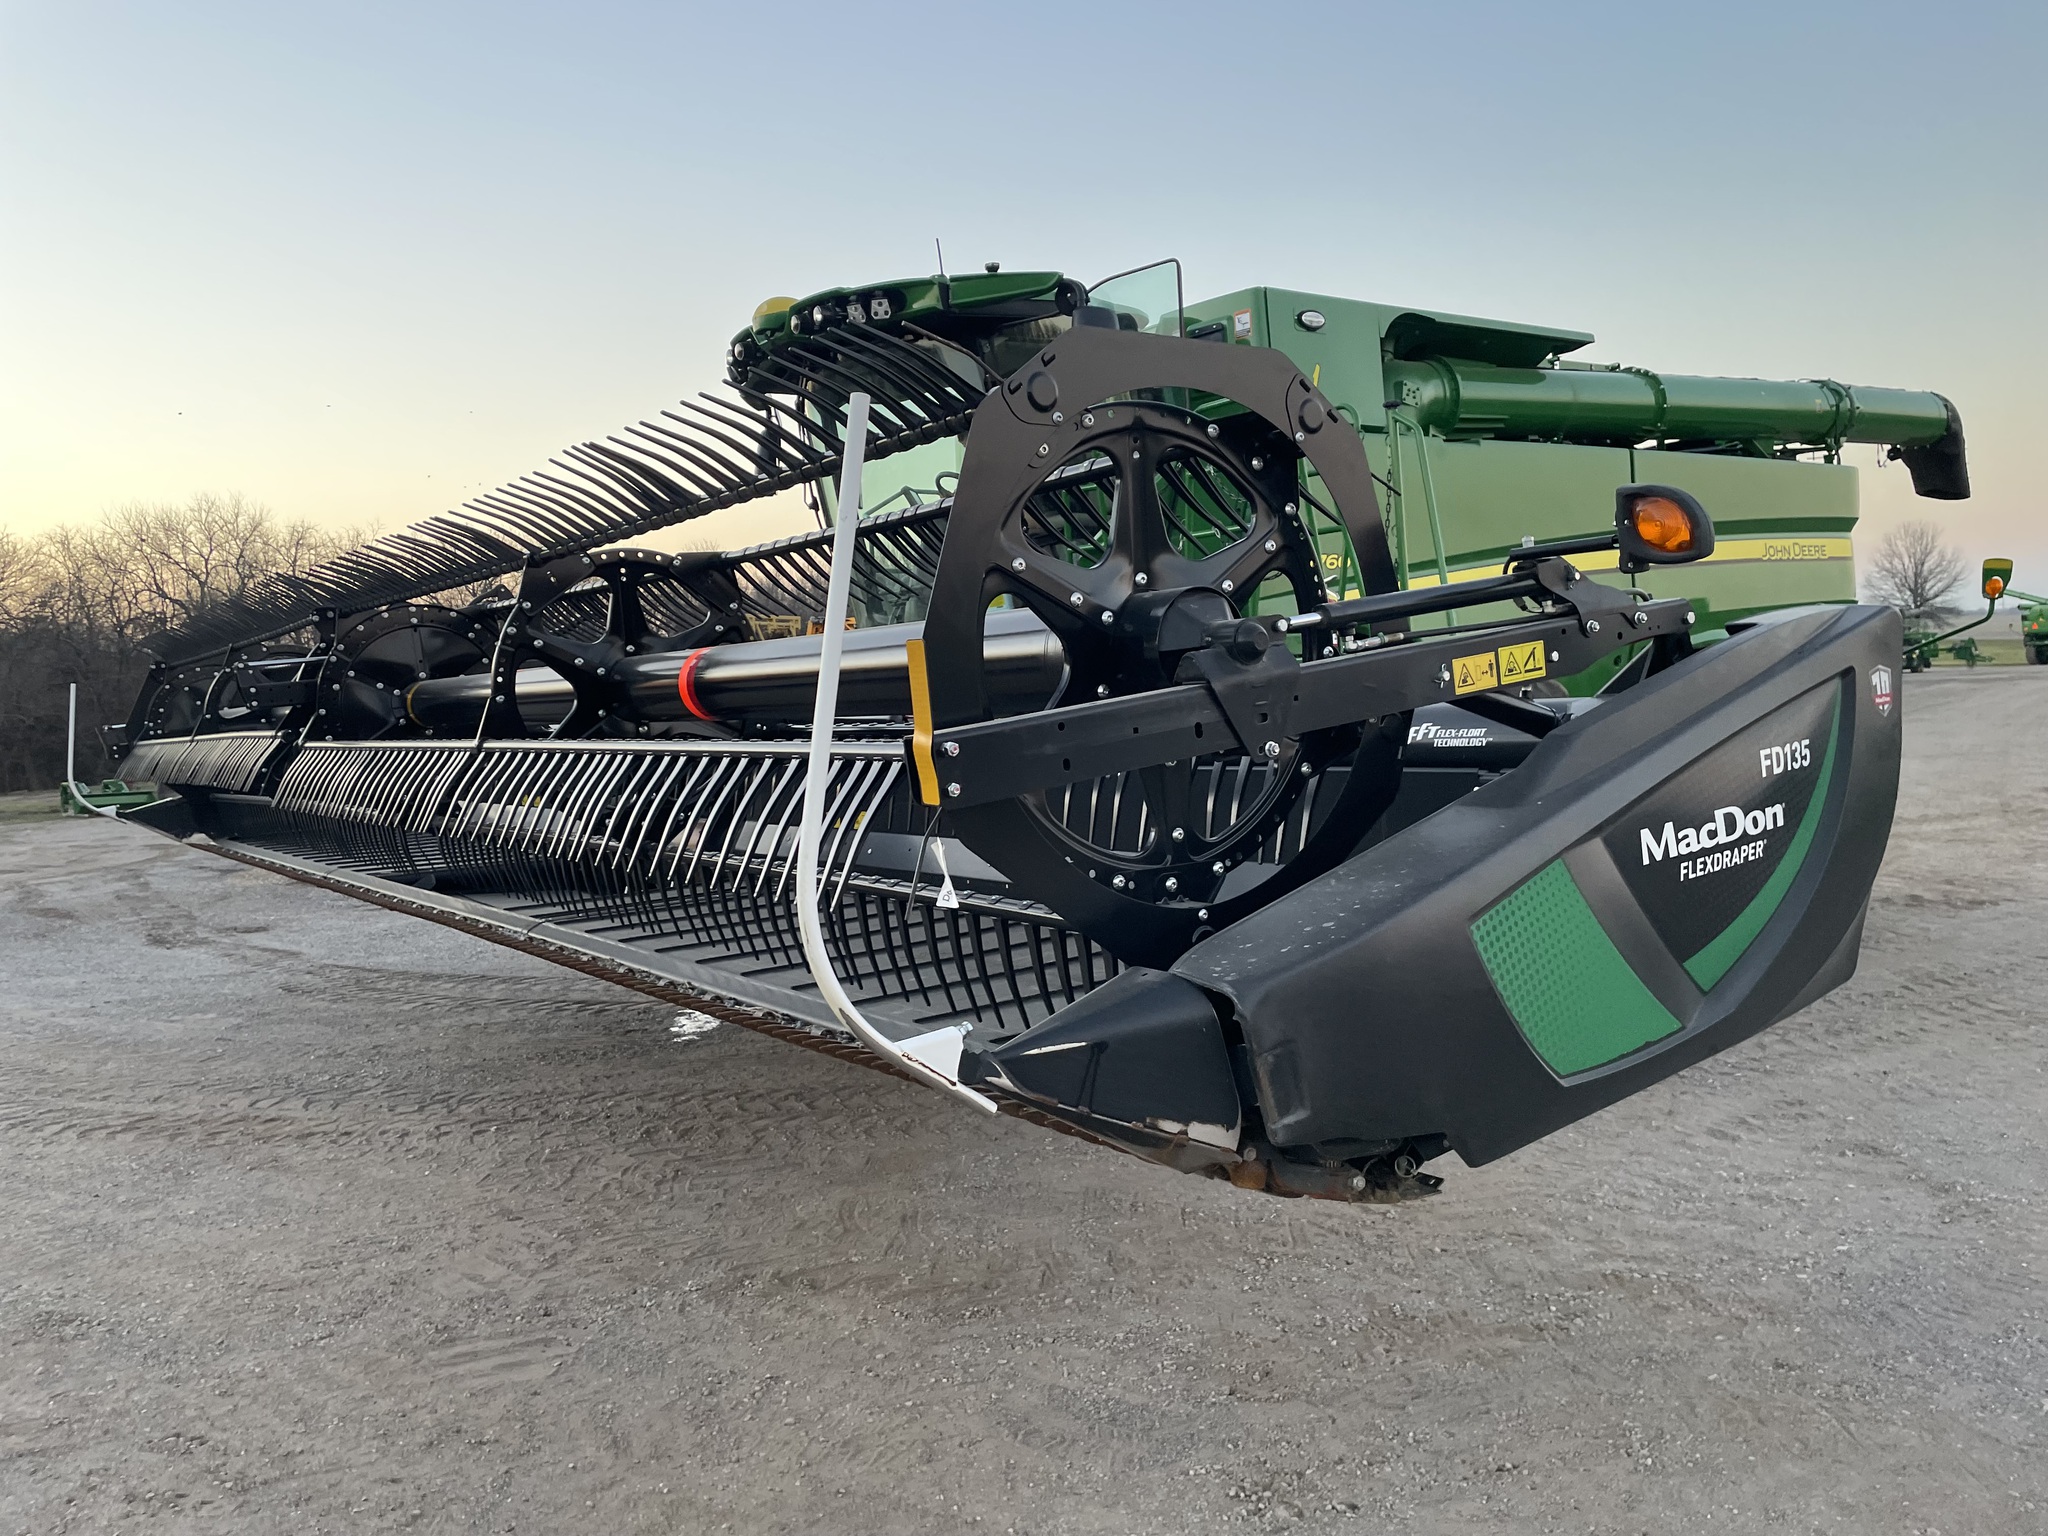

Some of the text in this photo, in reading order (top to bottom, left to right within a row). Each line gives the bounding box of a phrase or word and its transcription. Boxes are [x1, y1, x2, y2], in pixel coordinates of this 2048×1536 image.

[1762, 542, 1827, 558] JOHN DEERE
[1407, 722, 1441, 745] FFT
[1433, 737, 1489, 747] TECHNOLOGY
[1436, 727, 1487, 738] FLEX-FLOAT
[1759, 738, 1811, 778] FD135
[1640, 803, 1785, 866] MacDon
[1679, 840, 1765, 882] FLEXDRAPER
